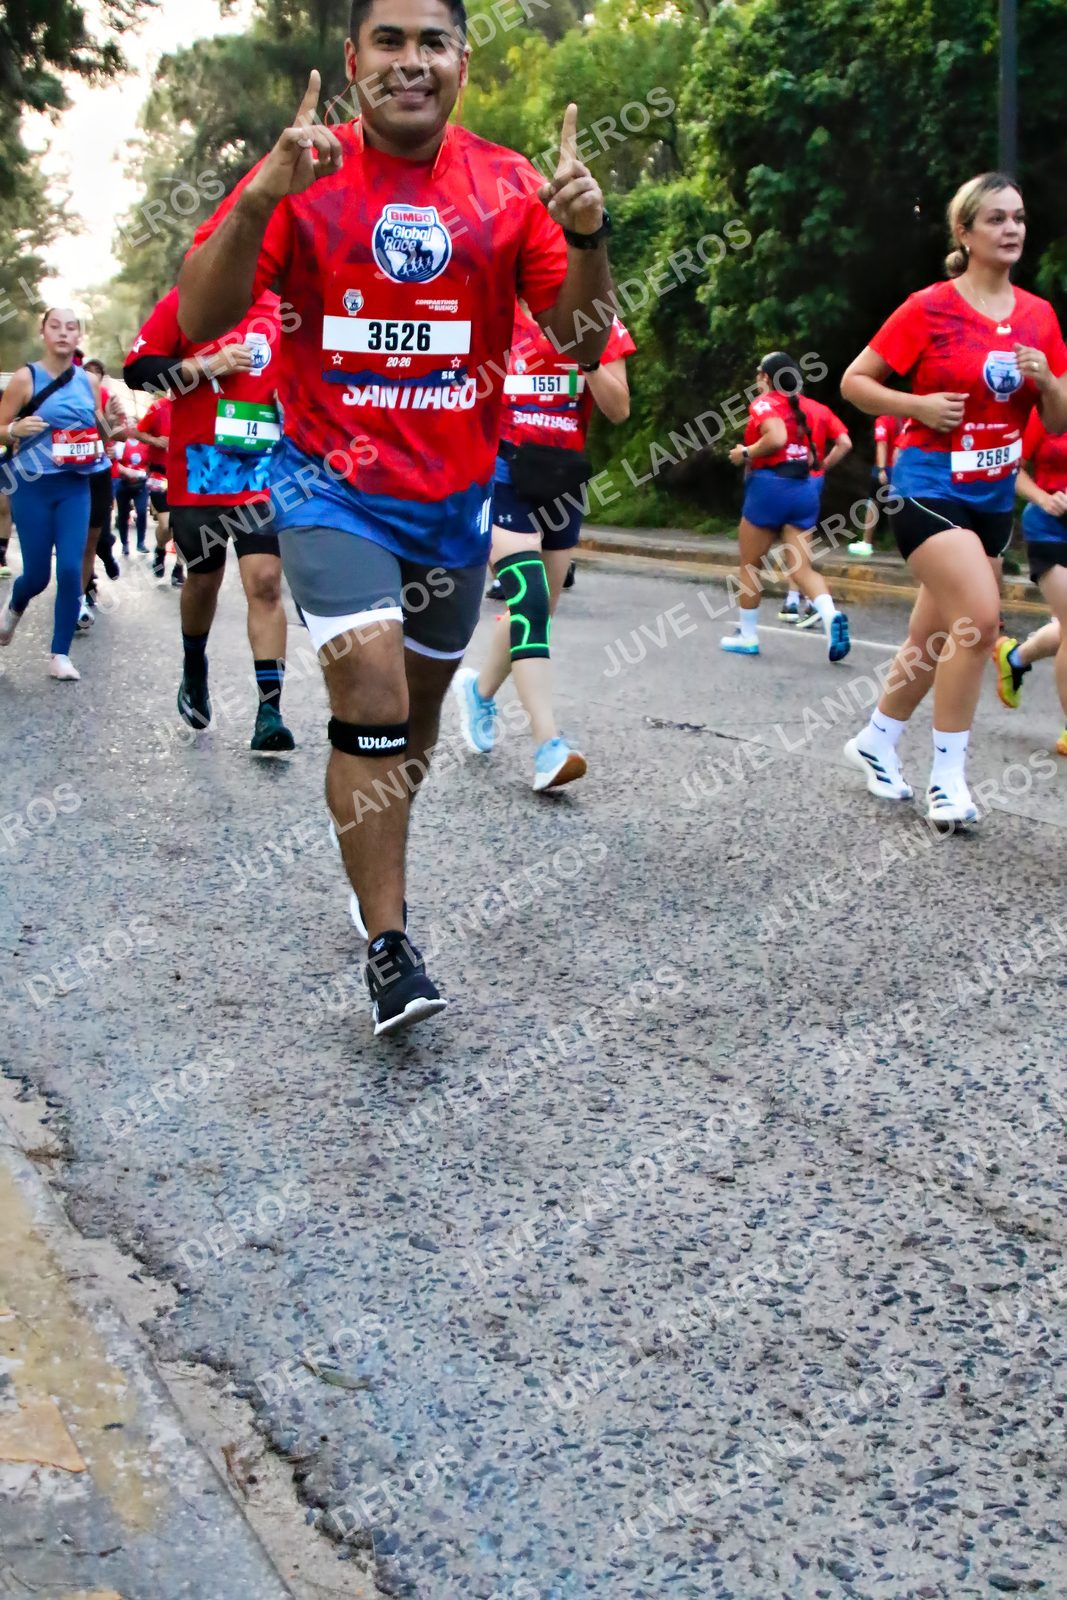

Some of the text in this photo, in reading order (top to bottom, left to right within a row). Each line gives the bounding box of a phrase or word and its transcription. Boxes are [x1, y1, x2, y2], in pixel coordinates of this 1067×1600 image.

[390, 211, 431, 222] BIMBO
[393, 225, 432, 241] Global
[384, 236, 417, 251] Race
[367, 321, 432, 351] 3526
[531, 376, 561, 392] 1551
[246, 421, 258, 437] 14
[69, 443, 91, 455] 2017
[976, 446, 1011, 468] 2589
[357, 736, 406, 749] Wilson
